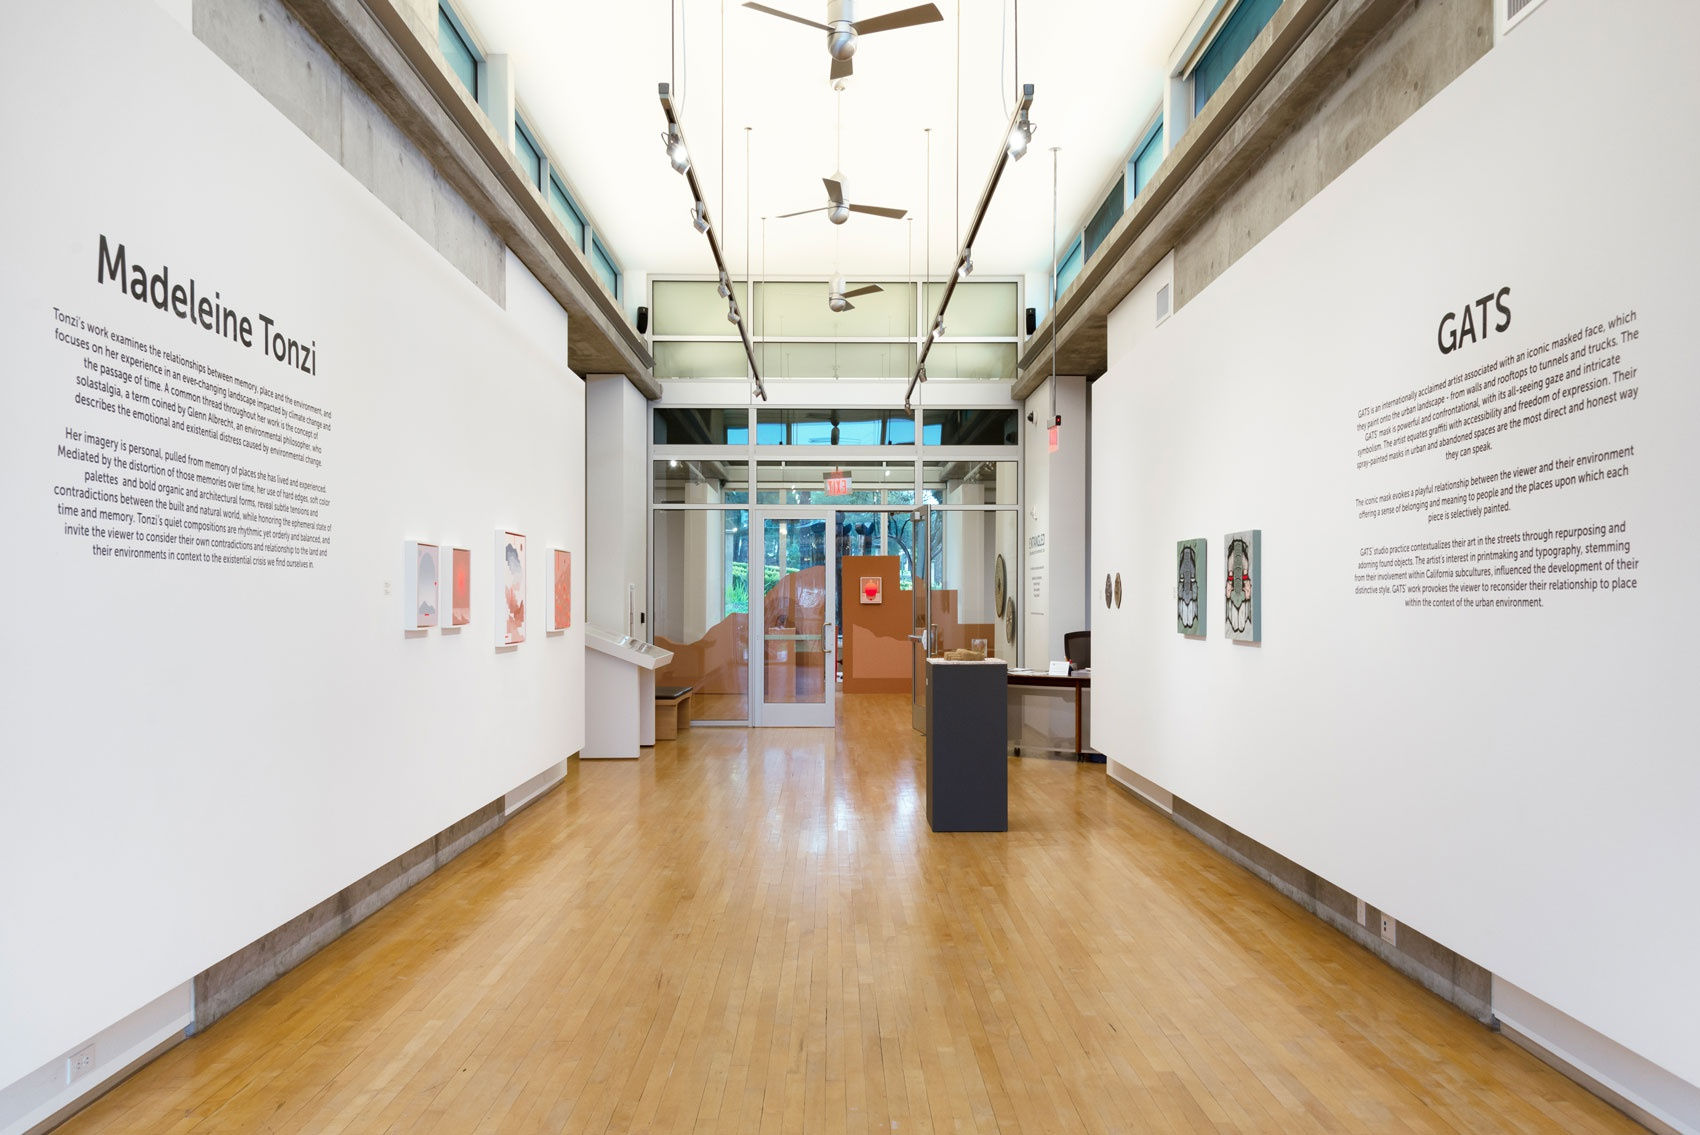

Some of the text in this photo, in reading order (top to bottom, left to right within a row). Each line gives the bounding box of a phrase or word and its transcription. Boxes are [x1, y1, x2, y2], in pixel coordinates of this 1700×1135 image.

[98, 234, 316, 376] Madeleine Tonzi
[1438, 286, 1511, 354] GATS
[87, 324, 107, 338] work
[110, 332, 147, 352] examines
[149, 344, 160, 357] the
[163, 351, 205, 375] relationships
[1483, 328, 1638, 389] and rooftops to tunnels and trucks. The
[1499, 308, 1636, 368] with an iconic masked face, which
[54, 327, 226, 398] focuses on her experience in an ever-changing
[83, 357, 221, 410] the passage of time. A common thread
[1482, 391, 1496, 405] with
[1507, 379, 1542, 397] all-seeing
[1545, 373, 1563, 388] gaze
[1566, 364, 1580, 379] and
[1583, 355, 1620, 374] intricate
[76, 375, 206, 420] solastalgia, a term coined by Glenn
[1503, 367, 1637, 414] and freedom of expression. Their
[74, 391, 217, 439] describes the emotional and existential
[1474, 387, 1638, 440] spaces are the most direct and honest way
[57, 444, 226, 487] Mediated by the distortion of those memories
[65, 426, 202, 467] Her imagery is personal, pulled from
[1470, 446, 1634, 485] between the viewer and their environment
[53, 486, 221, 516] contradictions between the built and natural
[84, 470, 197, 497] palettes and bold organic and
[1476, 487, 1498, 502] people
[1500, 484, 1512, 496] and
[1515, 482, 1526, 493] the
[1528, 480, 1552, 494] places
[1554, 476, 1575, 489] upon
[1578, 468, 1603, 483] which
[1606, 463, 1628, 479] each
[57, 503, 78, 516] time
[80, 506, 96, 518] and
[99, 511, 134, 525] memory.
[164, 517, 181, 529] quiet
[184, 521, 225, 532] compositions
[64, 523, 88, 536] invite
[92, 525, 105, 537] the
[107, 528, 133, 540] viewer
[136, 532, 143, 540] to
[146, 532, 176, 543] consider
[178, 534, 193, 545] their
[1467, 520, 1625, 546] art in the streets through repurposing and
[92, 544, 111, 556] their
[114, 547, 166, 559] environments
[168, 550, 174, 560] in
[176, 553, 201, 561] context
[211, 553, 221, 562] the
[1470, 540, 1630, 563] in printmaking and typography, stemming
[1494, 558, 1638, 575] influenced the development of their
[1475, 597, 1493, 606] urban
[1490, 580, 1526, 591] reconsider
[1529, 579, 1546, 590] their
[1549, 578, 1597, 592] relationship
[1600, 579, 1609, 589] to
[1612, 576, 1637, 592] place
